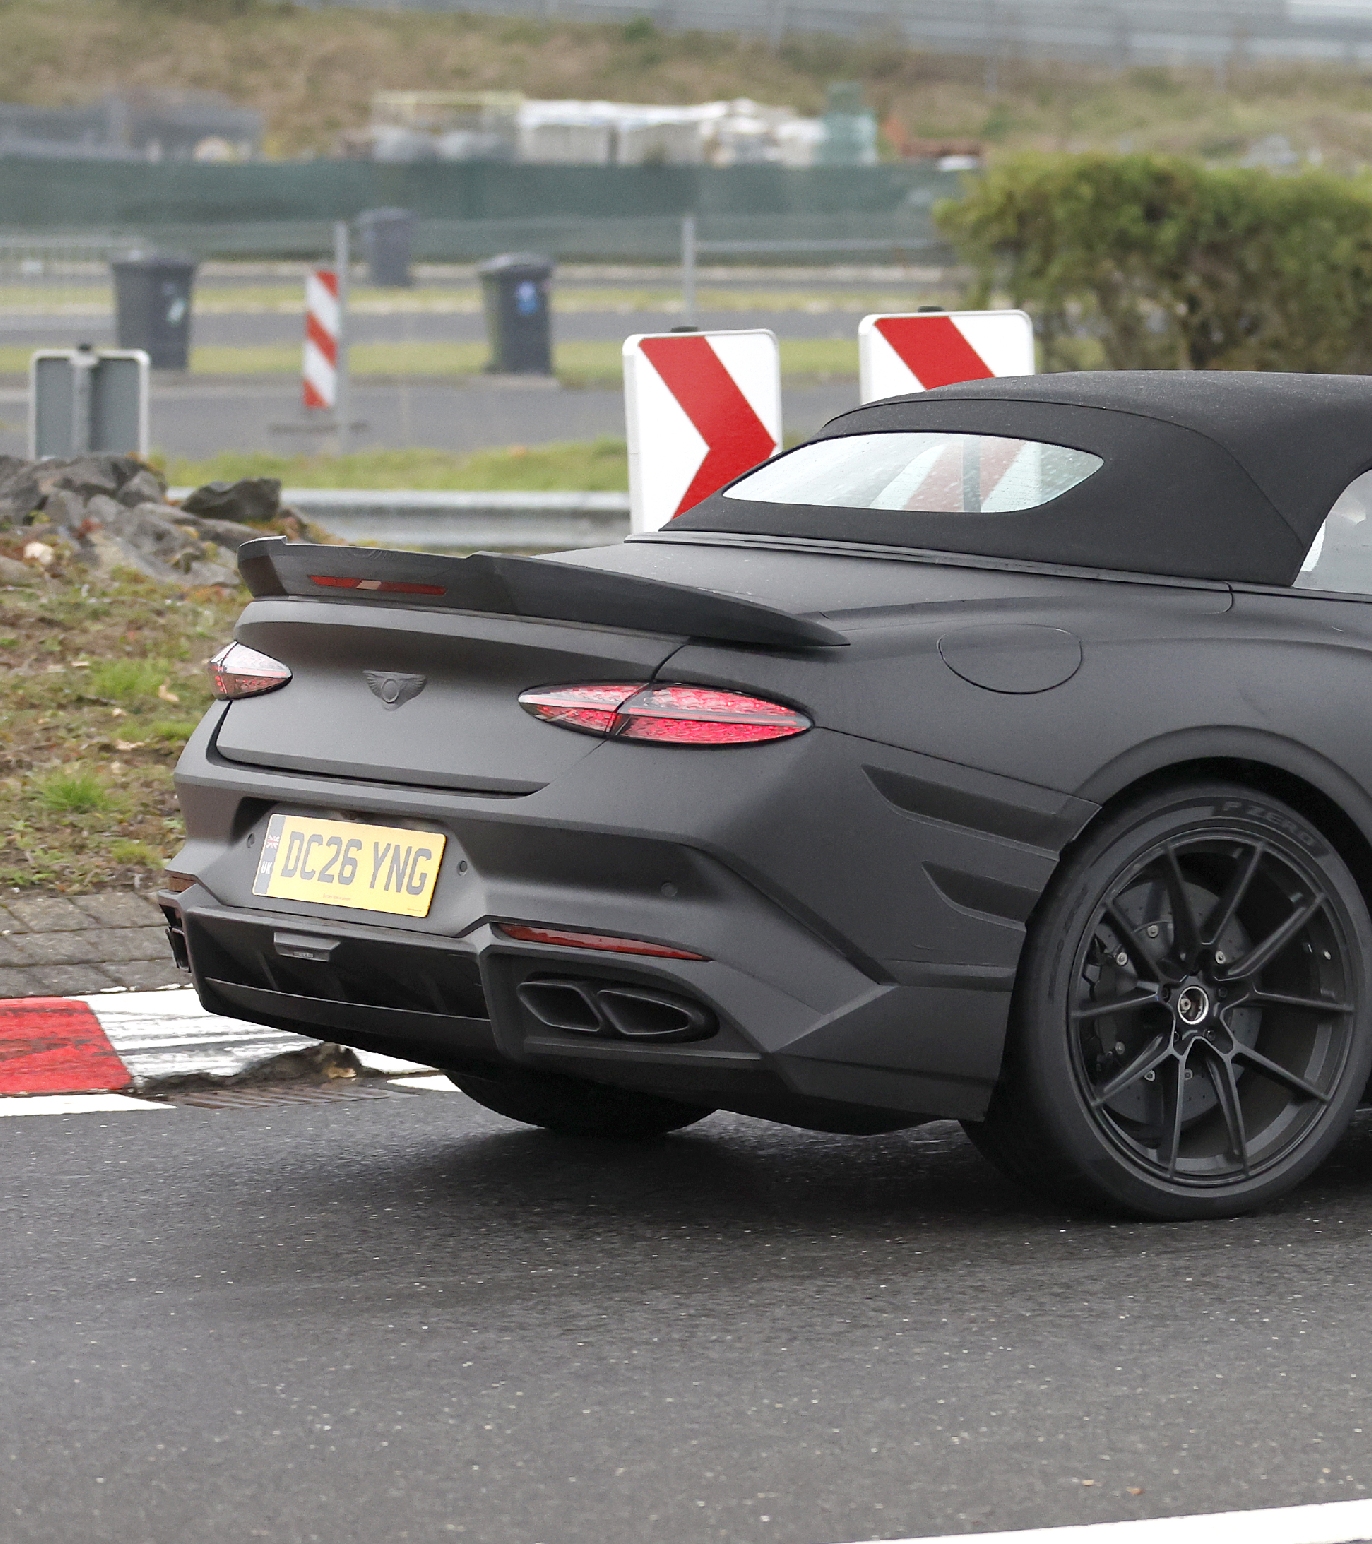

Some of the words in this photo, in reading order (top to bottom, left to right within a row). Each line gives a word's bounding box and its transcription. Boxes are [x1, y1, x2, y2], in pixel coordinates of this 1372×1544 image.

[260, 861, 273, 875] UK
[281, 831, 362, 885] DC26
[369, 841, 432, 896] YNG
